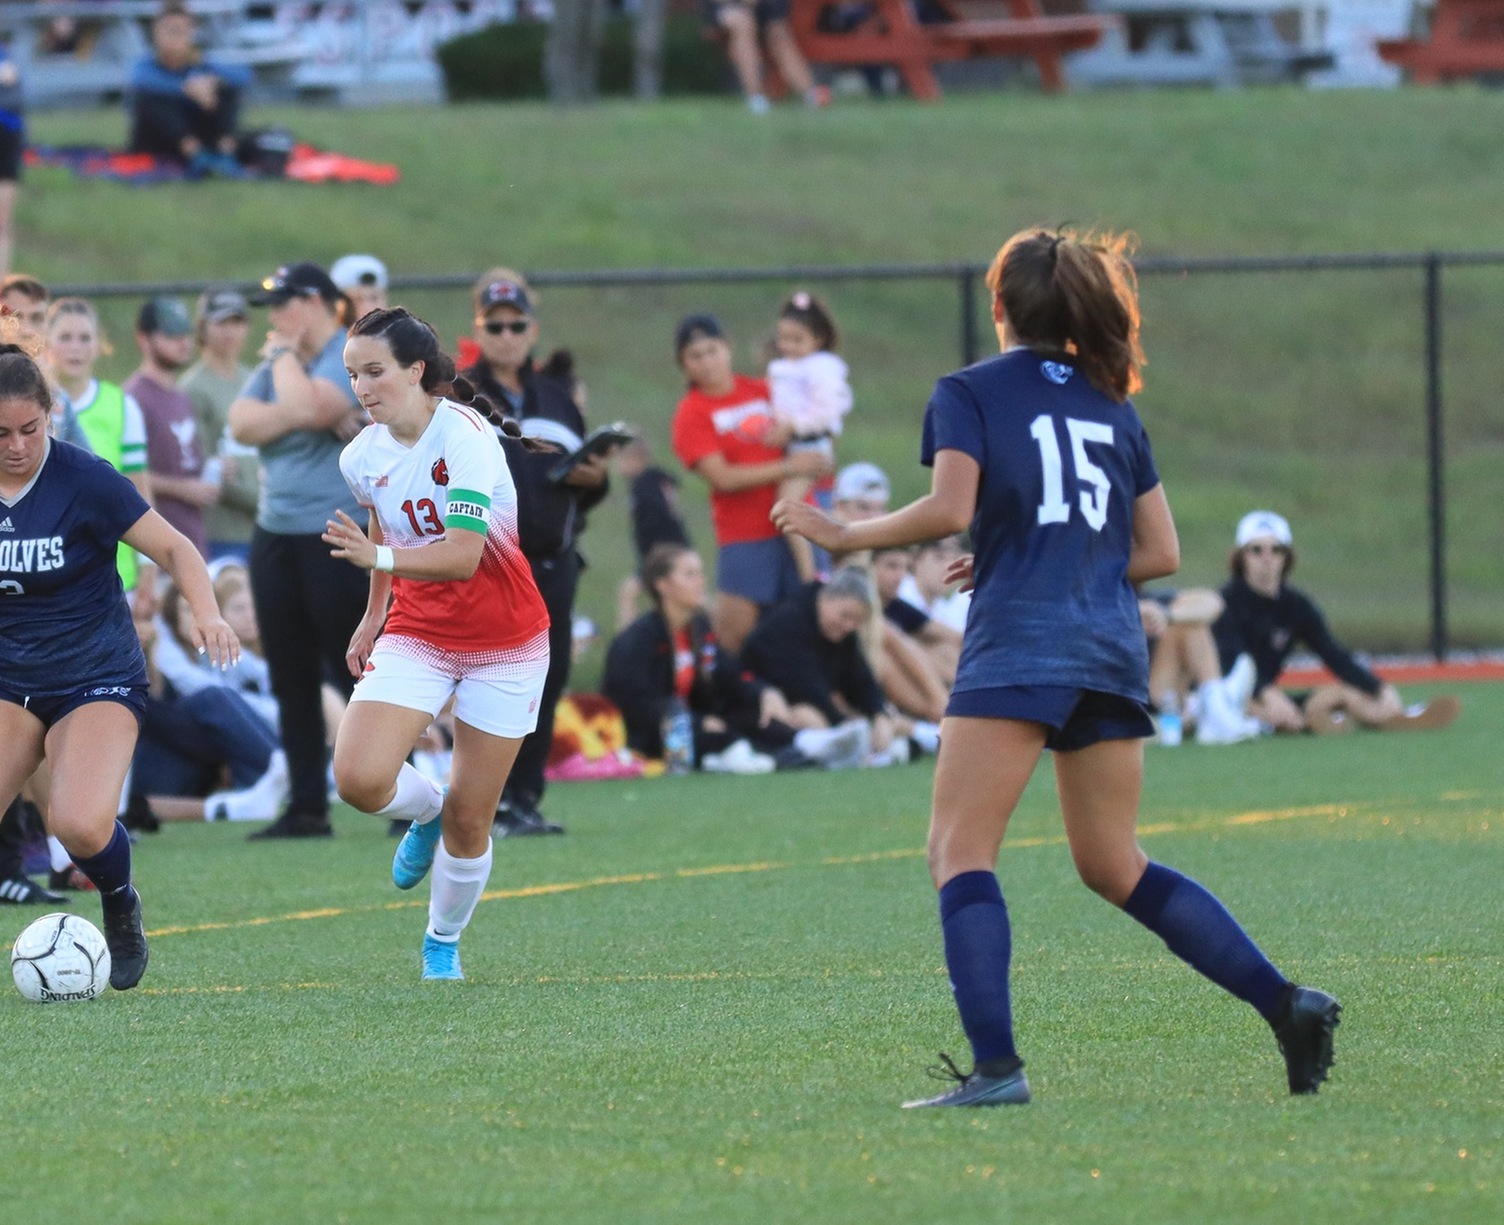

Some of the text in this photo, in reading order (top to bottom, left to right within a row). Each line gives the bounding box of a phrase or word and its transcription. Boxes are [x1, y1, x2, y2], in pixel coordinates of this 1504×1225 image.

[1030, 415, 1114, 531] 15
[401, 498, 445, 537] 13
[449, 502, 484, 519] CAPTAIN
[40, 984, 96, 1002] SPALDING
